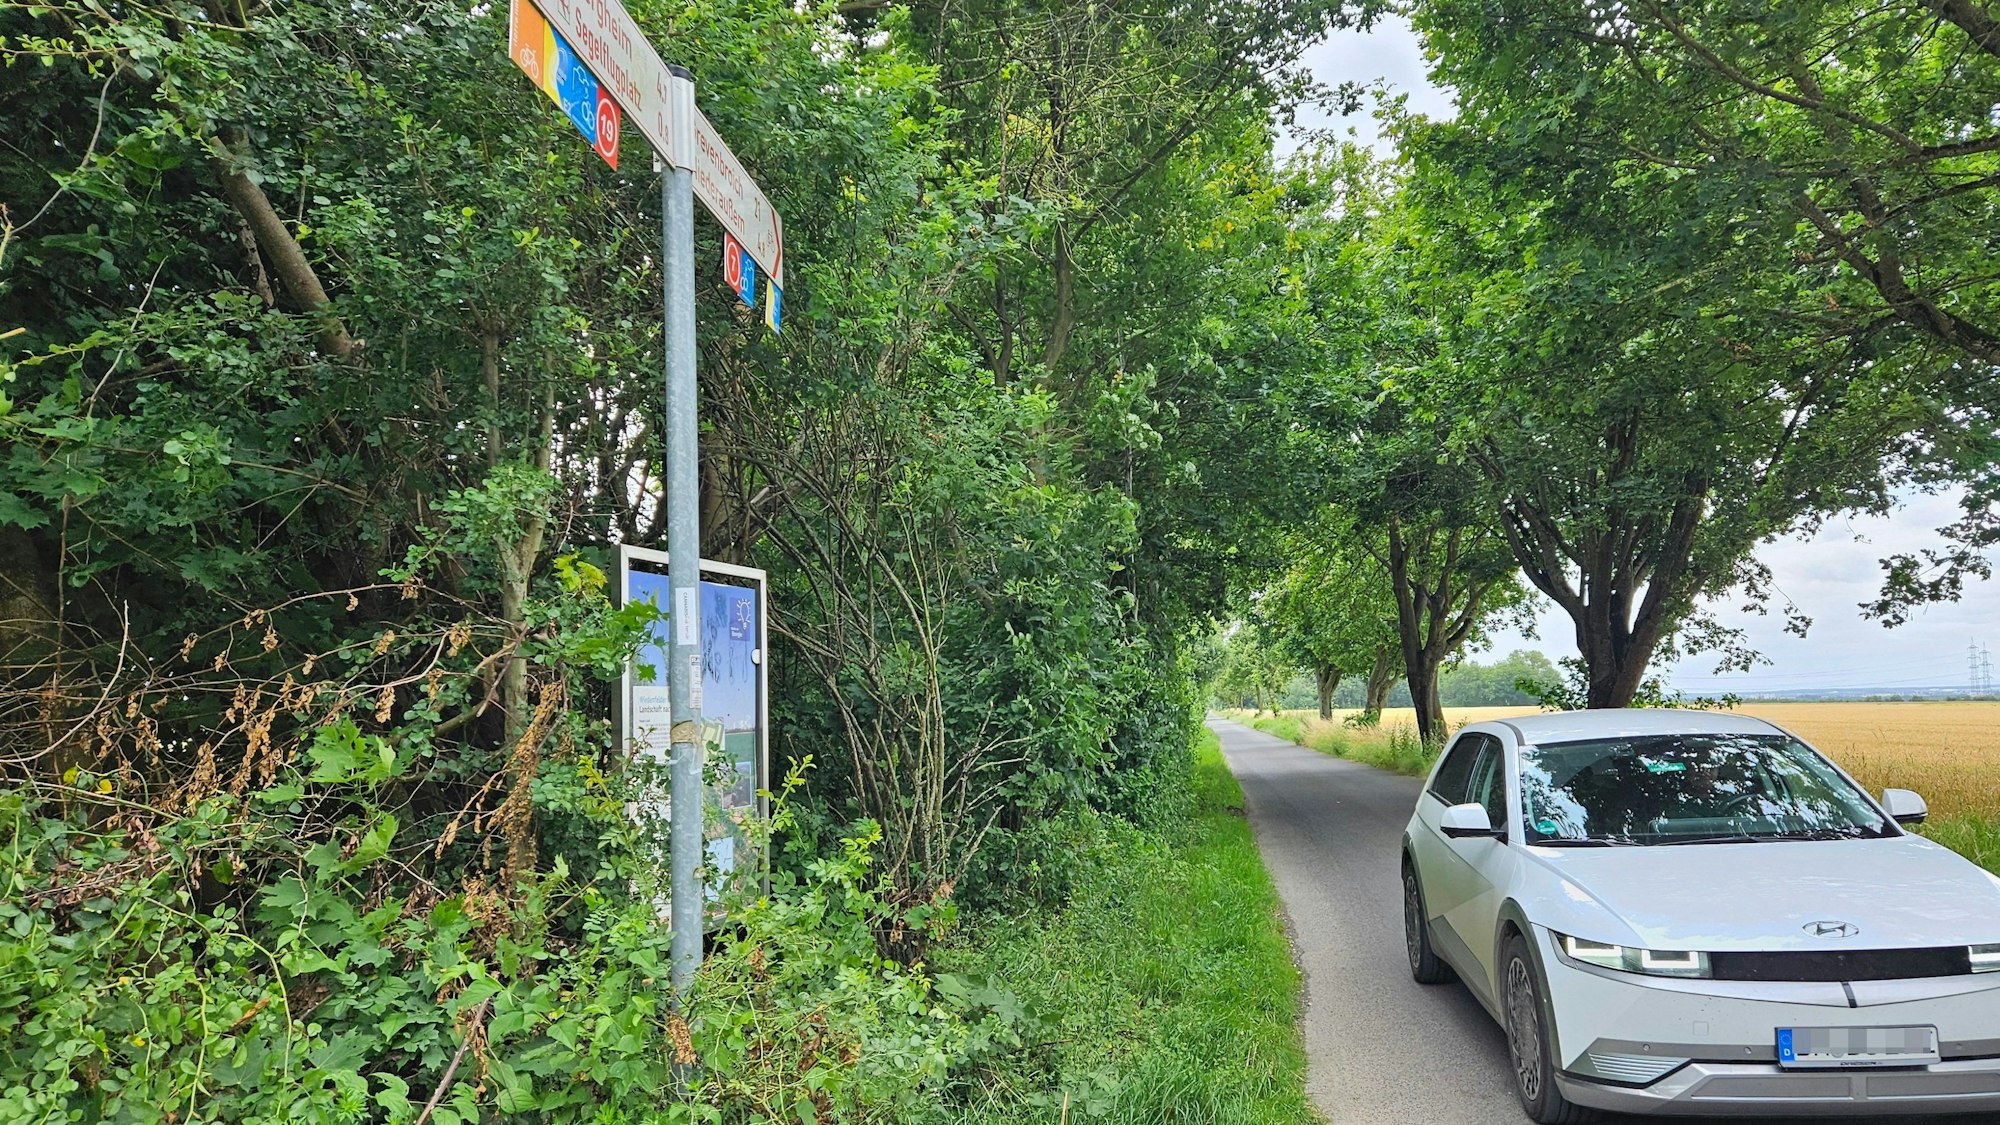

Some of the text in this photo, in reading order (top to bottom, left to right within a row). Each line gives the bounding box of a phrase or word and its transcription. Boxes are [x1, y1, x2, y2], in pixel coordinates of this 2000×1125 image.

[576, 6, 642, 112] Segelflugplatz
[601, 114, 614, 142] 19
[694, 127, 743, 200] revenbroich
[731, 254, 737, 272] 7
